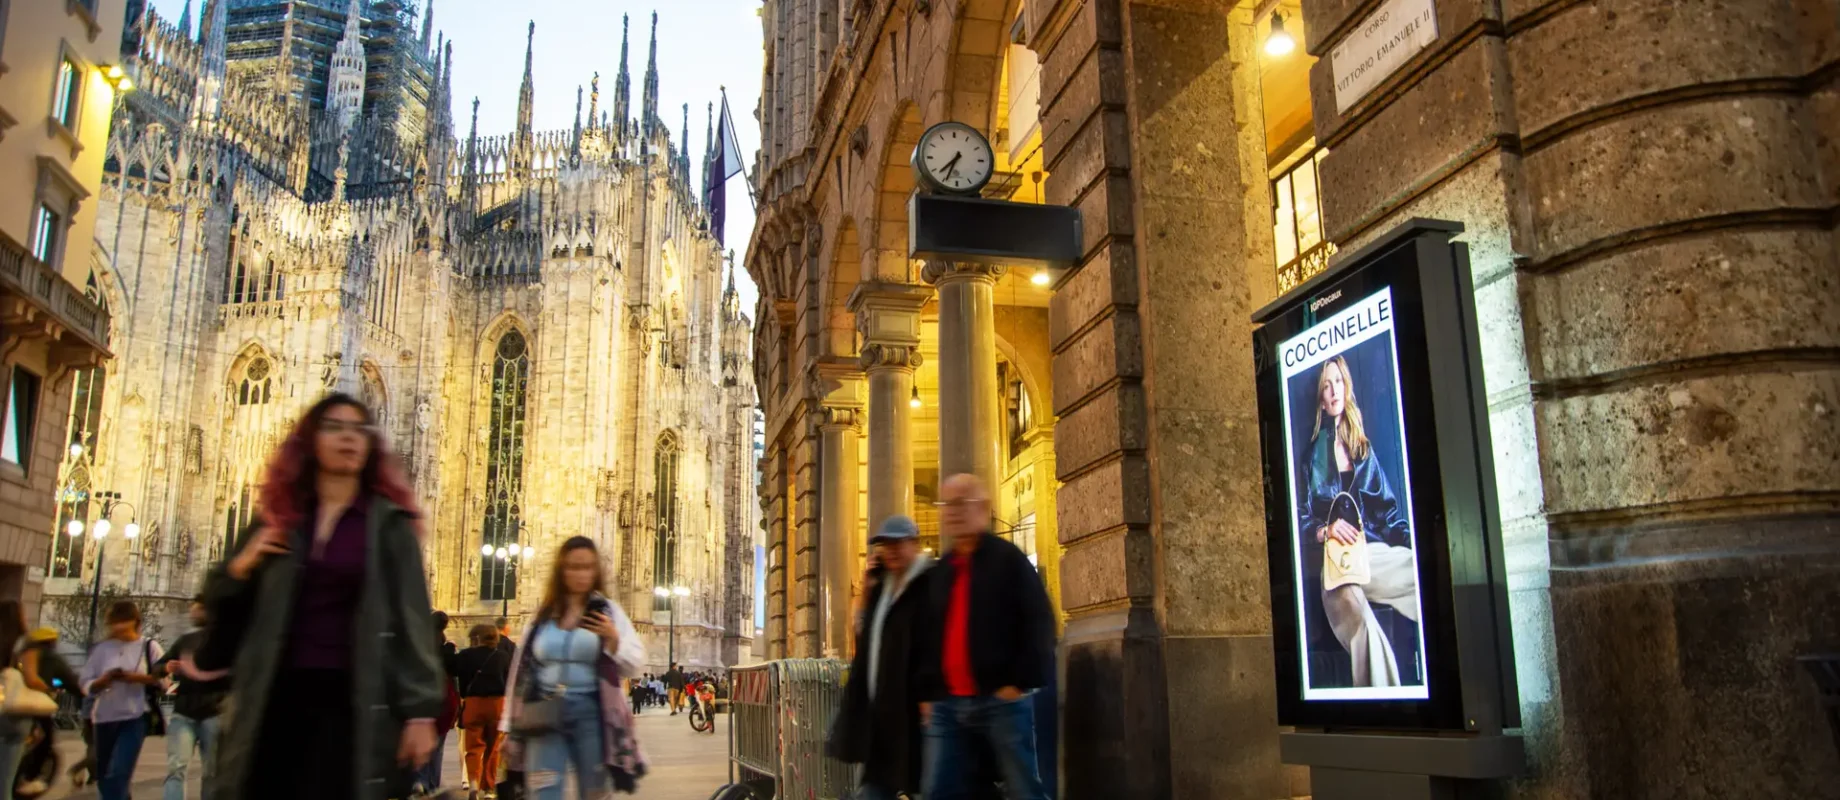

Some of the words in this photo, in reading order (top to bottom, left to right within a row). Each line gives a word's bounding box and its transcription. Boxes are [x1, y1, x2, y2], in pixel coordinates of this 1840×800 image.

[1364, 11, 1390, 38] CORSO
[1337, 56, 1374, 92] VITTORIO
[1377, 18, 1420, 61] EMANUELE
[1423, 8, 1430, 22] II
[1310, 289, 1342, 313] IGPDecaux
[1285, 299, 1390, 367] COCCINELLE
